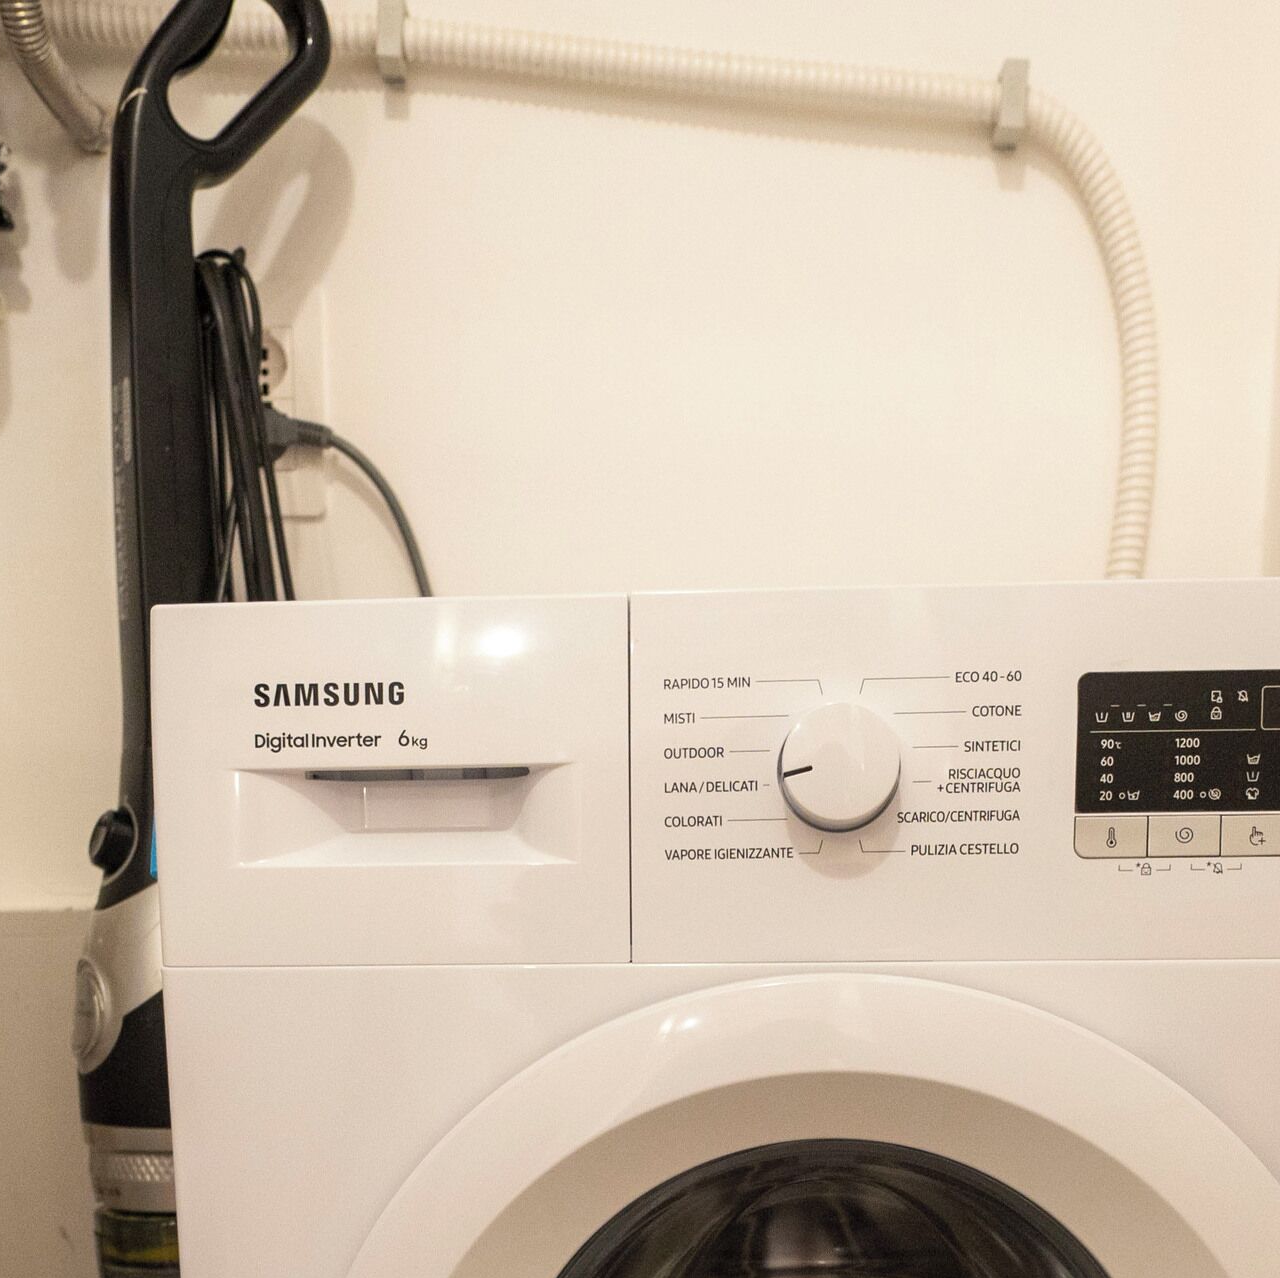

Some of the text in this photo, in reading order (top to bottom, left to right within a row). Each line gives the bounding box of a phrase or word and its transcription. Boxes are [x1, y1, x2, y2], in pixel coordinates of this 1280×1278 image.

[663, 676, 751, 690] RAPIDO 15 MIN
[955, 671, 980, 683] ECO
[254, 681, 405, 708] SAMSUNG
[972, 704, 1022, 717] COTONE
[663, 712, 696, 724] MISTI
[963, 740, 1021, 753] SINTETICI
[1175, 737, 1201, 749] 1200
[663, 747, 725, 760] OUTDOOR
[1174, 754, 1201, 766] 1000
[1100, 756, 1114, 767] 60
[948, 767, 1021, 780] RISCIACQUO
[1099, 773, 1114, 784] 40
[1173, 771, 1195, 783] 800
[1099, 790, 1113, 801] 20
[1173, 789, 1194, 800] 400
[664, 815, 723, 828] COLORATI
[897, 809, 1021, 824] SCARICO/CENTRIFUGA
[664, 847, 794, 861] VAPORE IGIENIZZANTE
[910, 842, 1020, 856] PULIZIA CESTELLO
